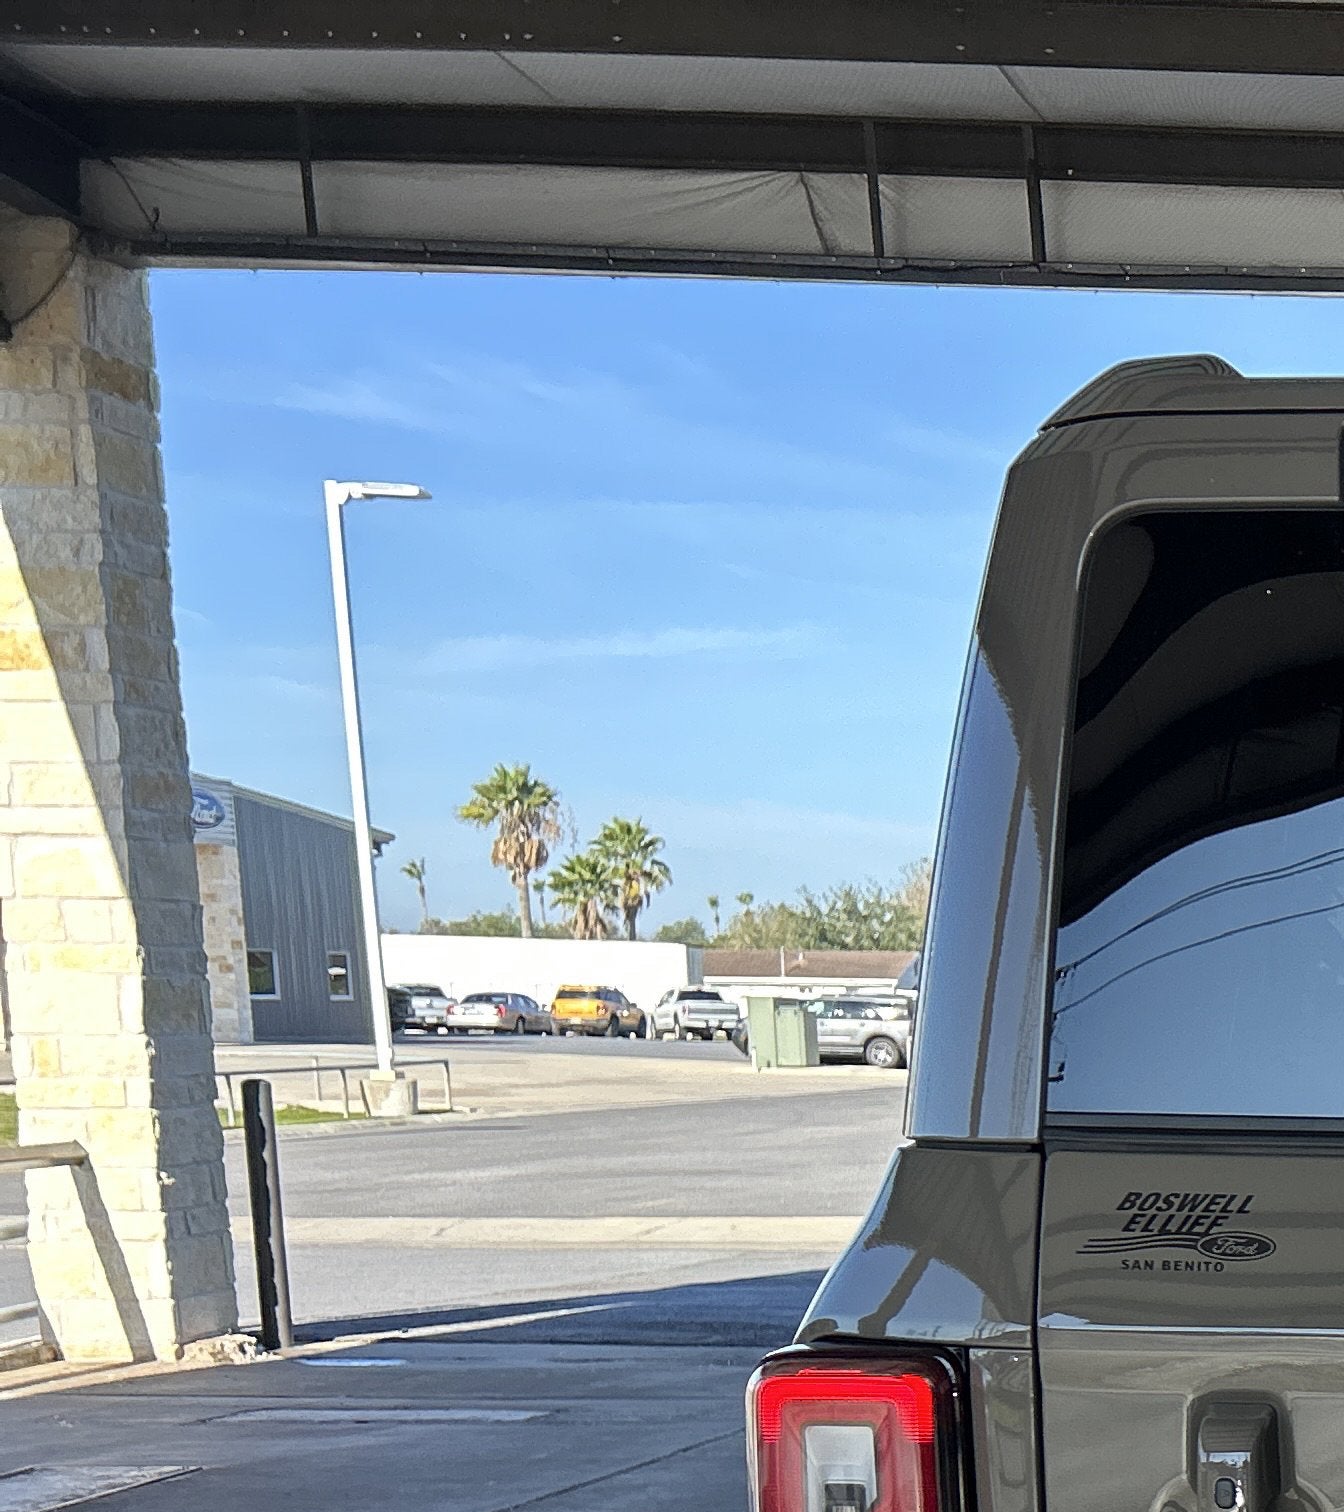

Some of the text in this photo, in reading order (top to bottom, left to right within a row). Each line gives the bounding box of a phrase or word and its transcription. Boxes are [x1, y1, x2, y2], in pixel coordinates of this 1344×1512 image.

[1116, 1191, 1255, 1214] BOSWELL
[1121, 1213, 1230, 1234] ELLIFF
[1212, 1236, 1259, 1255] Ford
[1121, 1259, 1225, 1273] SAN BENITO
